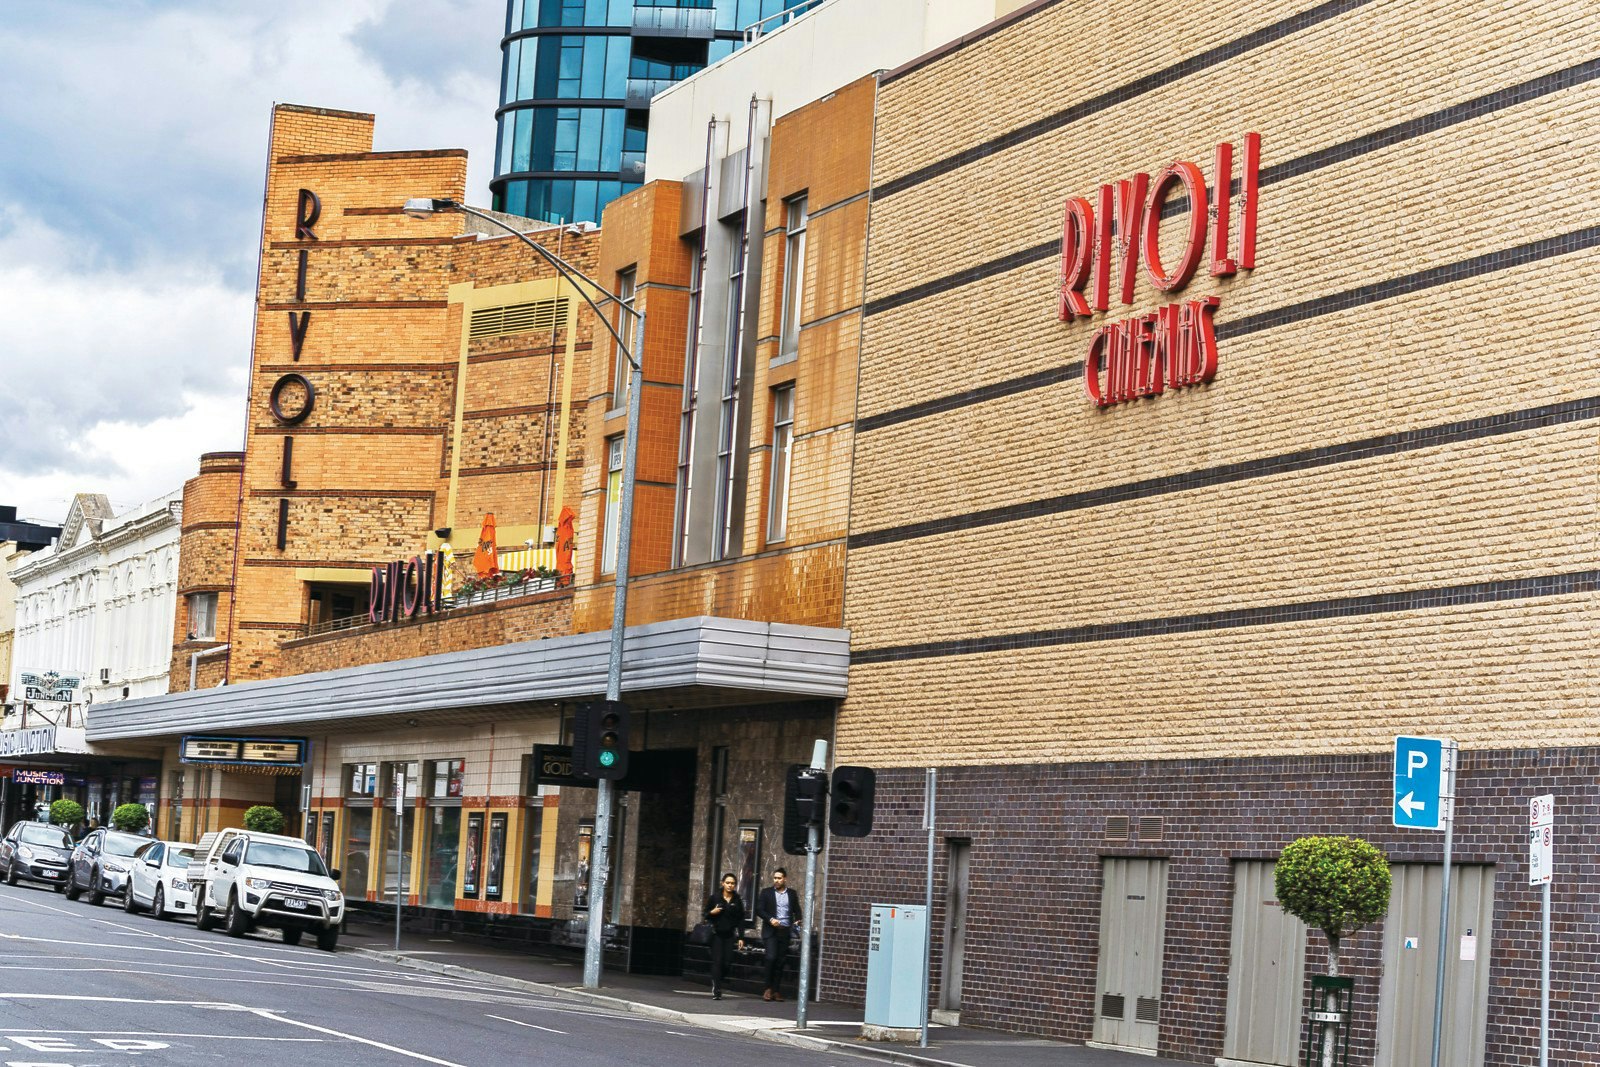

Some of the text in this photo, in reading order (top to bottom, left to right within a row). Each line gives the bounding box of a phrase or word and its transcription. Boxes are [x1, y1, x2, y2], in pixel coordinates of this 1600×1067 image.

[1058, 131, 1261, 322] RIVOLI
[269, 188, 321, 551] RIVOLI
[1082, 296, 1221, 407] CINEMAS
[368, 550, 444, 624] RIVOLI
[16, 769, 48, 778] MUSIC
[16, 777, 65, 785] JUNCTION
[543, 761, 573, 776] GOLD
[1407, 750, 1429, 779] P
